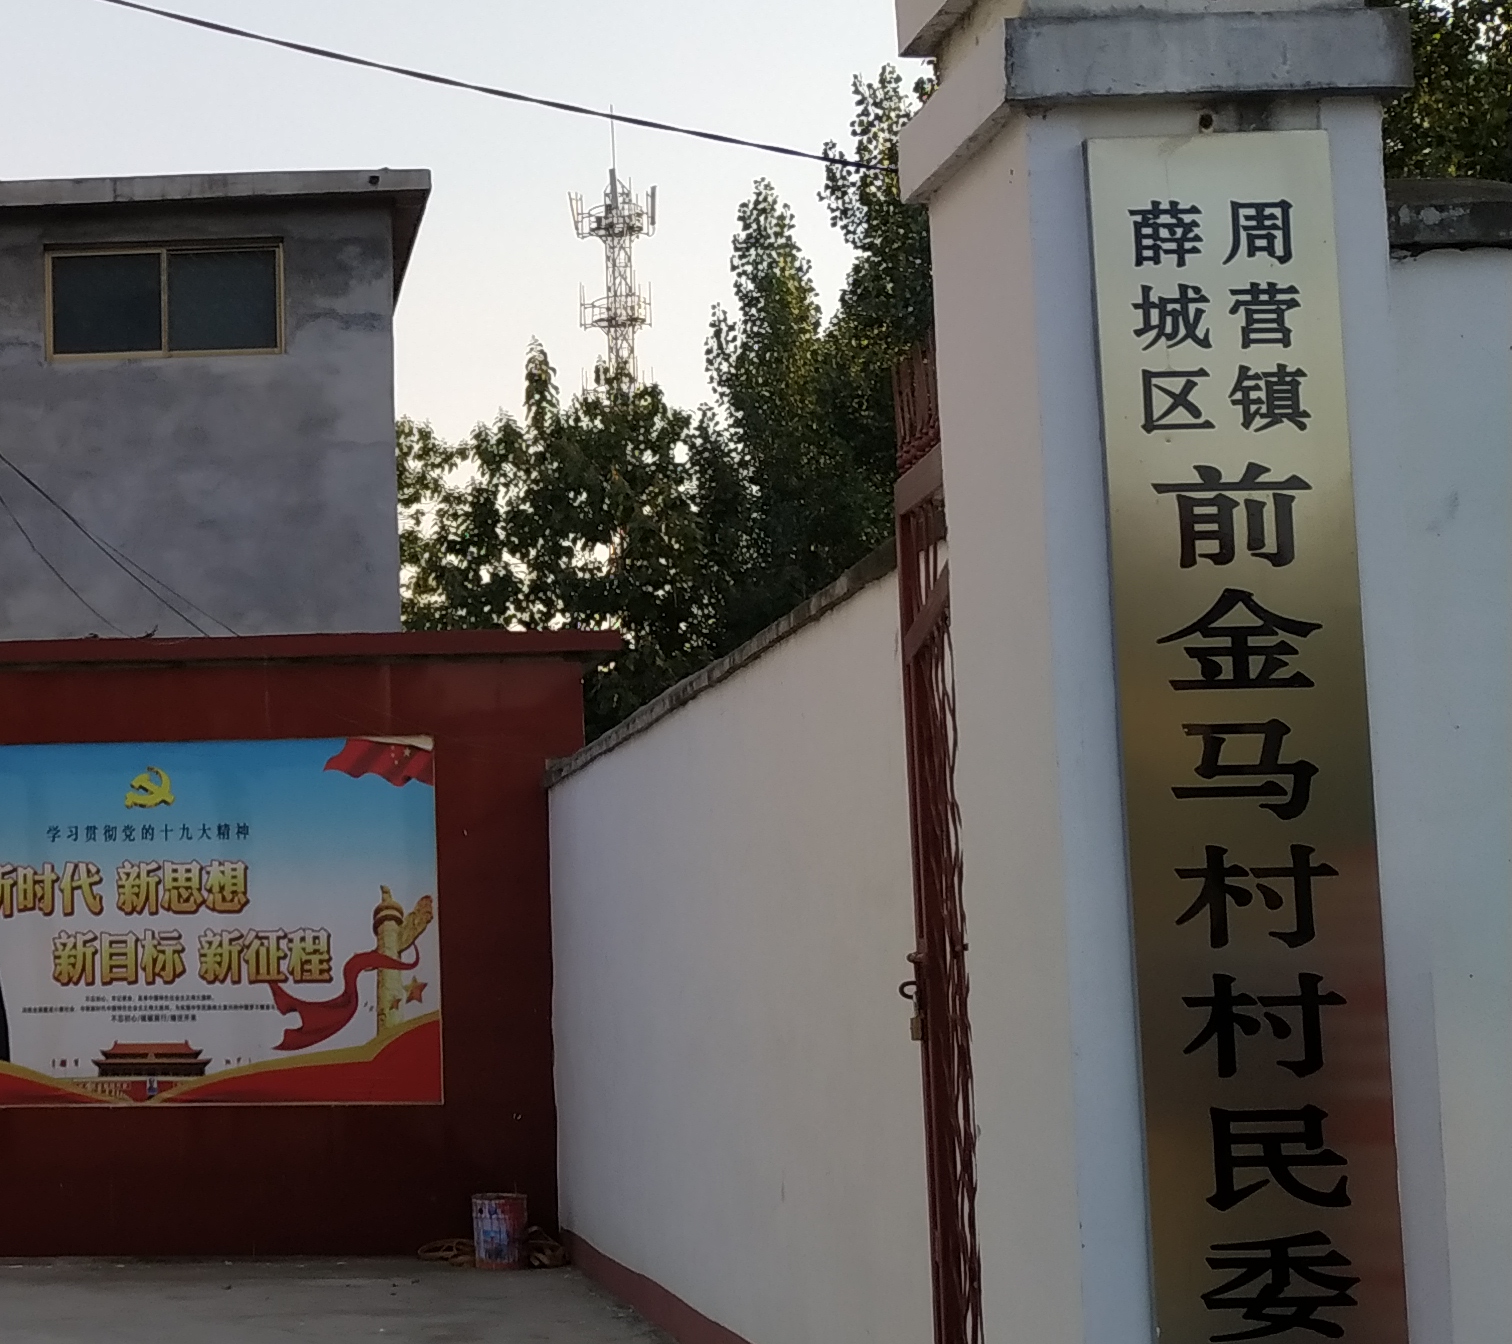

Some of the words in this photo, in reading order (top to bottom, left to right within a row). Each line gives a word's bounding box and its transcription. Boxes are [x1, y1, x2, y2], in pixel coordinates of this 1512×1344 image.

[1126, 199, 1217, 434] 薛城区
[1221, 197, 1312, 433] 周营镇
[45, 822, 251, 844] 学习贯彻党的十九大精神
[116, 859, 250, 915] 新思想
[52, 929, 186, 987] 新目标
[198, 926, 333, 985] 新征程
